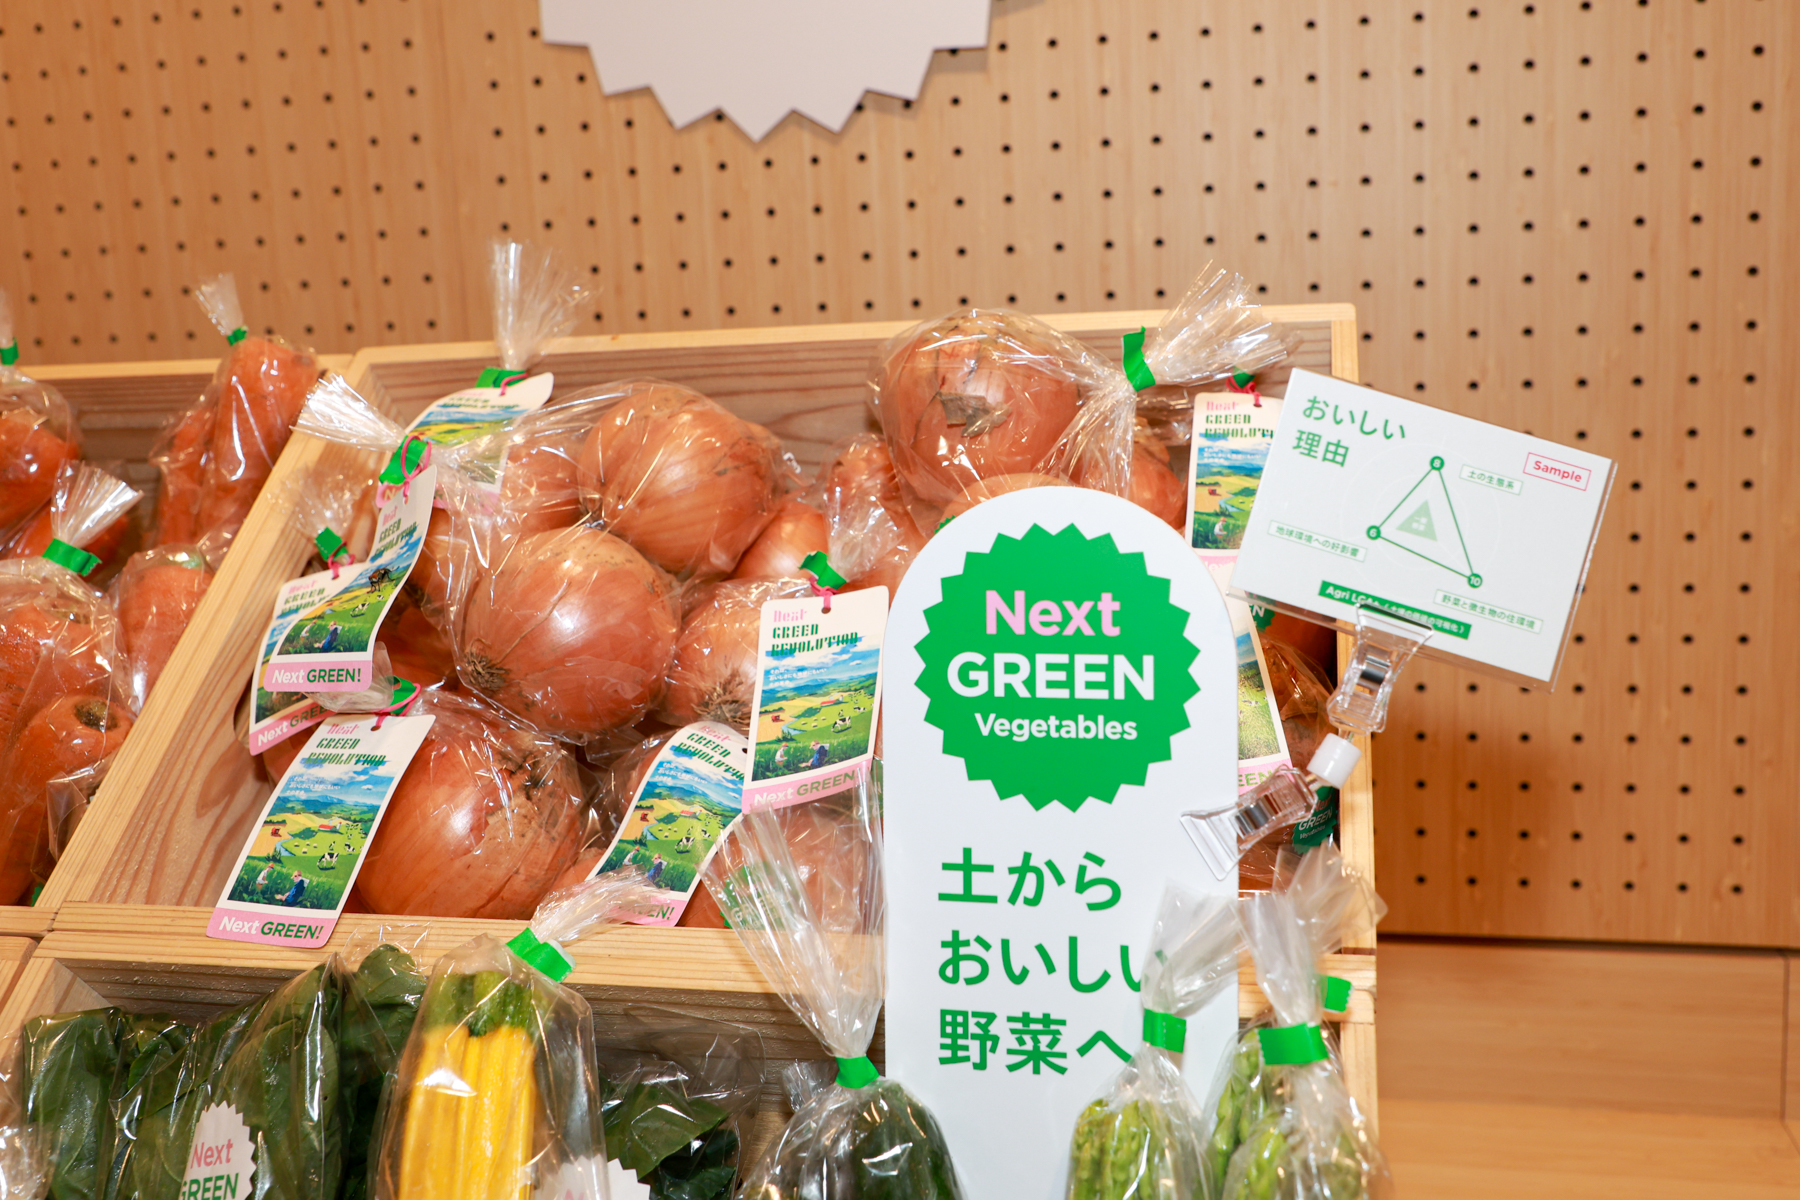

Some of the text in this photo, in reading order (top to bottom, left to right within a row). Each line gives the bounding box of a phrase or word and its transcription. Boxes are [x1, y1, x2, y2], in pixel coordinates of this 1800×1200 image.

[1303, 395, 1406, 440] おいしい
[1204, 427, 1275, 439] REVOLUTI
[1292, 429, 1350, 467] 理由
[1432, 458, 1442, 468] 8
[1533, 460, 1582, 483] Sample
[1467, 470, 1515, 490] 土の生態系
[1369, 528, 1378, 538] 6
[1325, 585, 1351, 600] Agri
[1469, 575, 1482, 587] 10
[985, 589, 1121, 637] Next
[772, 623, 819, 639] GREEN
[272, 668, 362, 684] Next GREEN!
[946, 651, 1155, 701] GREEN
[258, 721, 288, 746] Next
[974, 712, 1138, 742] Vegetables
[316, 738, 361, 750] GREEN
[687, 732, 731, 758] GREEN
[754, 787, 794, 807] Next
[1298, 806, 1334, 831] GREEN
[938, 847, 1122, 912] 土から
[219, 916, 325, 940] Next GREEN!
[938, 1008, 1133, 1076] 野菜へ
[190, 1139, 234, 1169] Next
